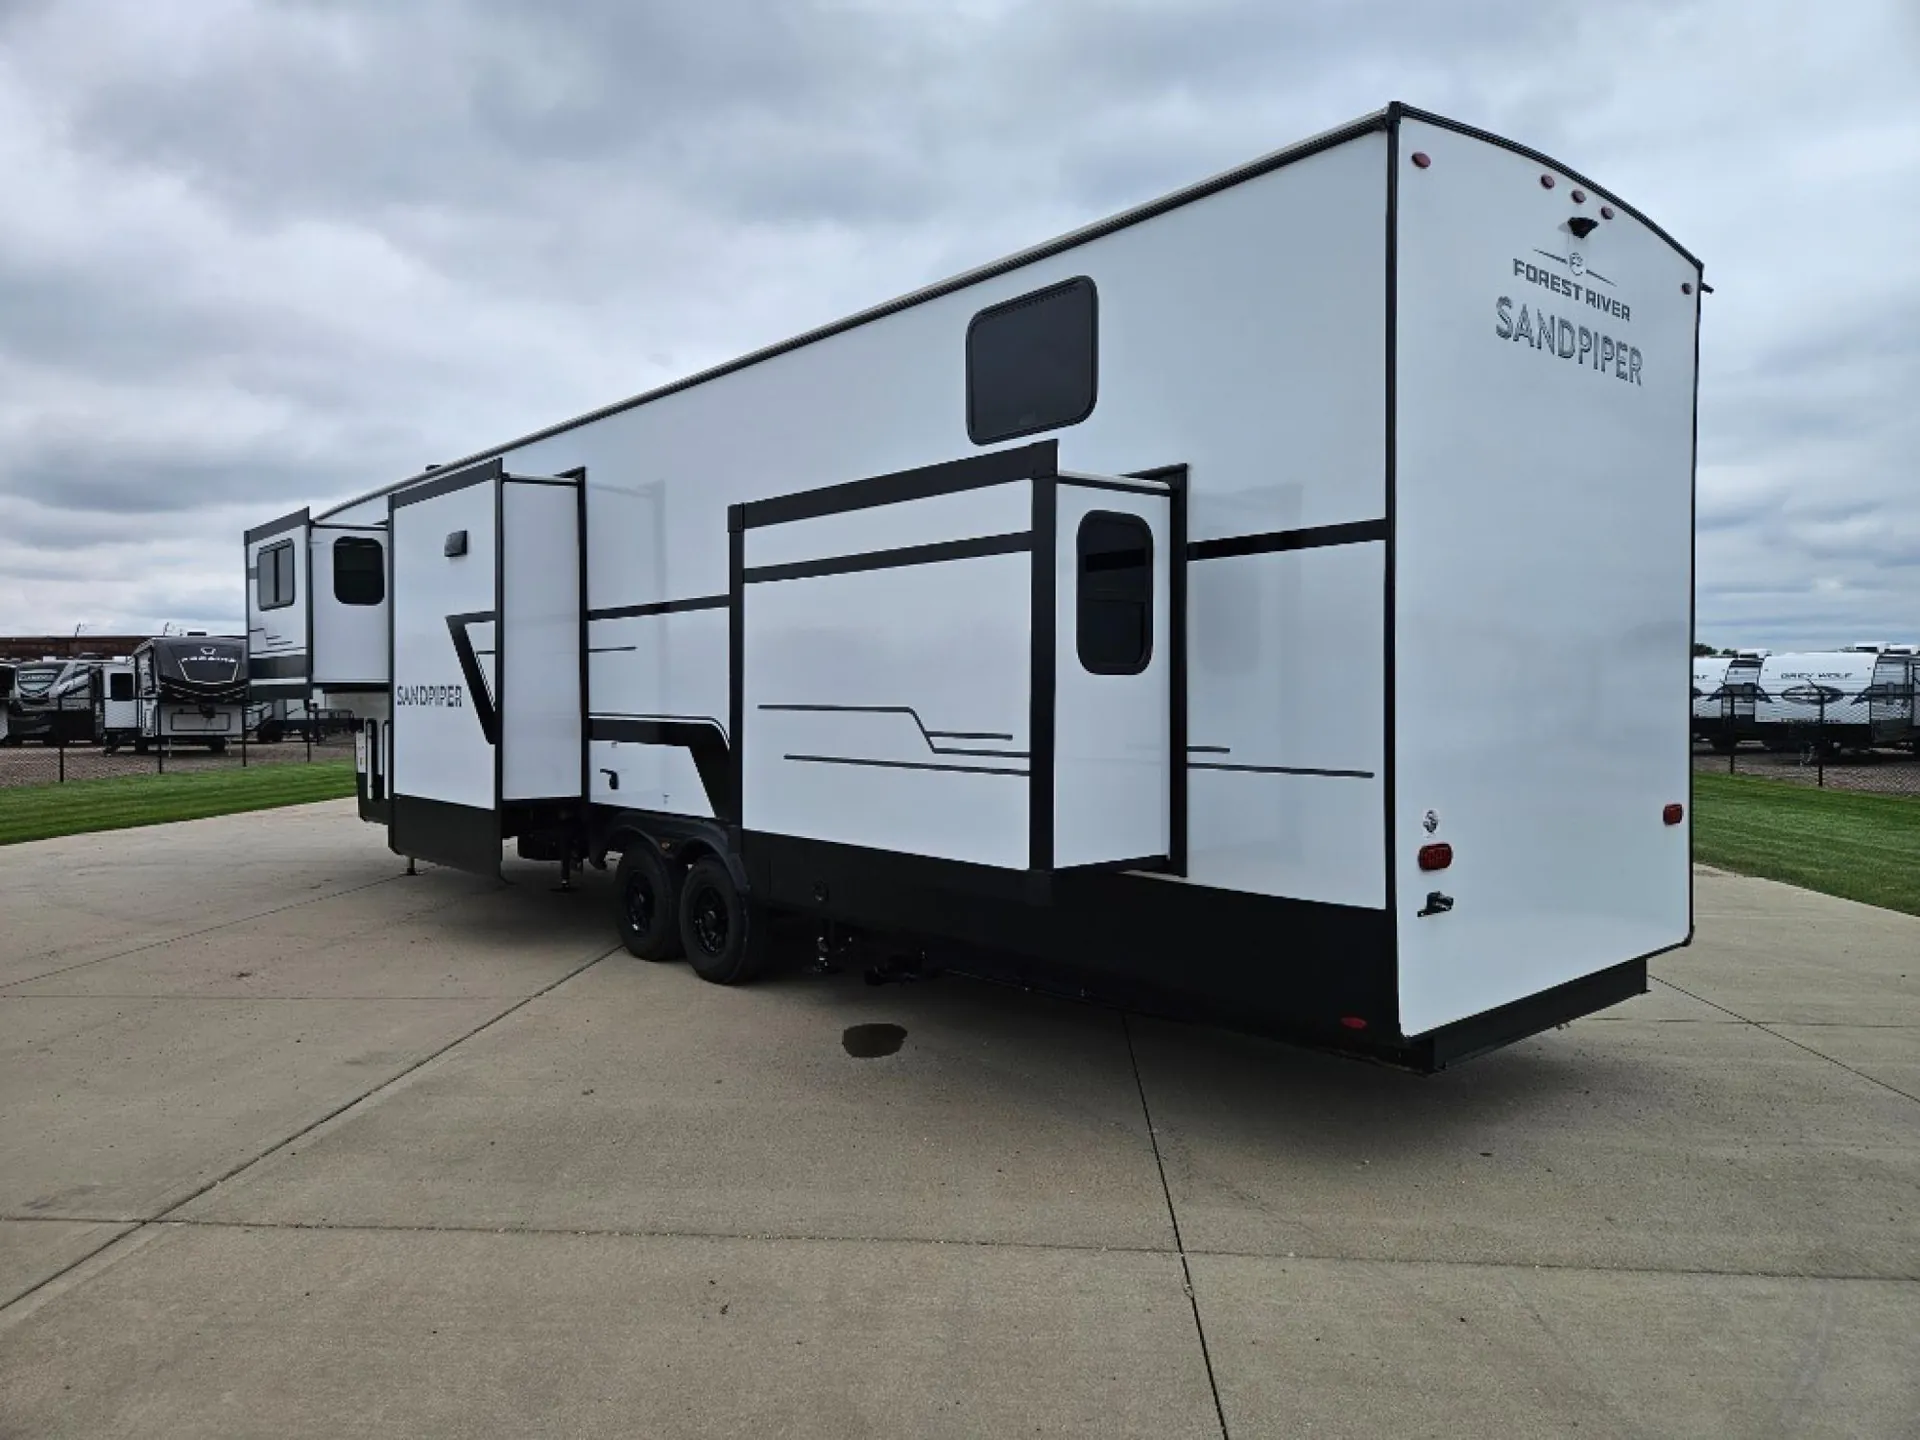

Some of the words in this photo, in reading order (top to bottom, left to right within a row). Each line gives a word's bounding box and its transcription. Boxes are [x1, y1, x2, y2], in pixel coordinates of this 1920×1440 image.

[1513, 258, 1582, 301] FOREST
[1585, 288, 1630, 321] RIVER
[1496, 296, 1643, 386] SANDPIPER
[397, 685, 463, 708] SANDPIPER
[1780, 672, 1814, 680] GREY
[1818, 672, 1853, 680] WOLF
